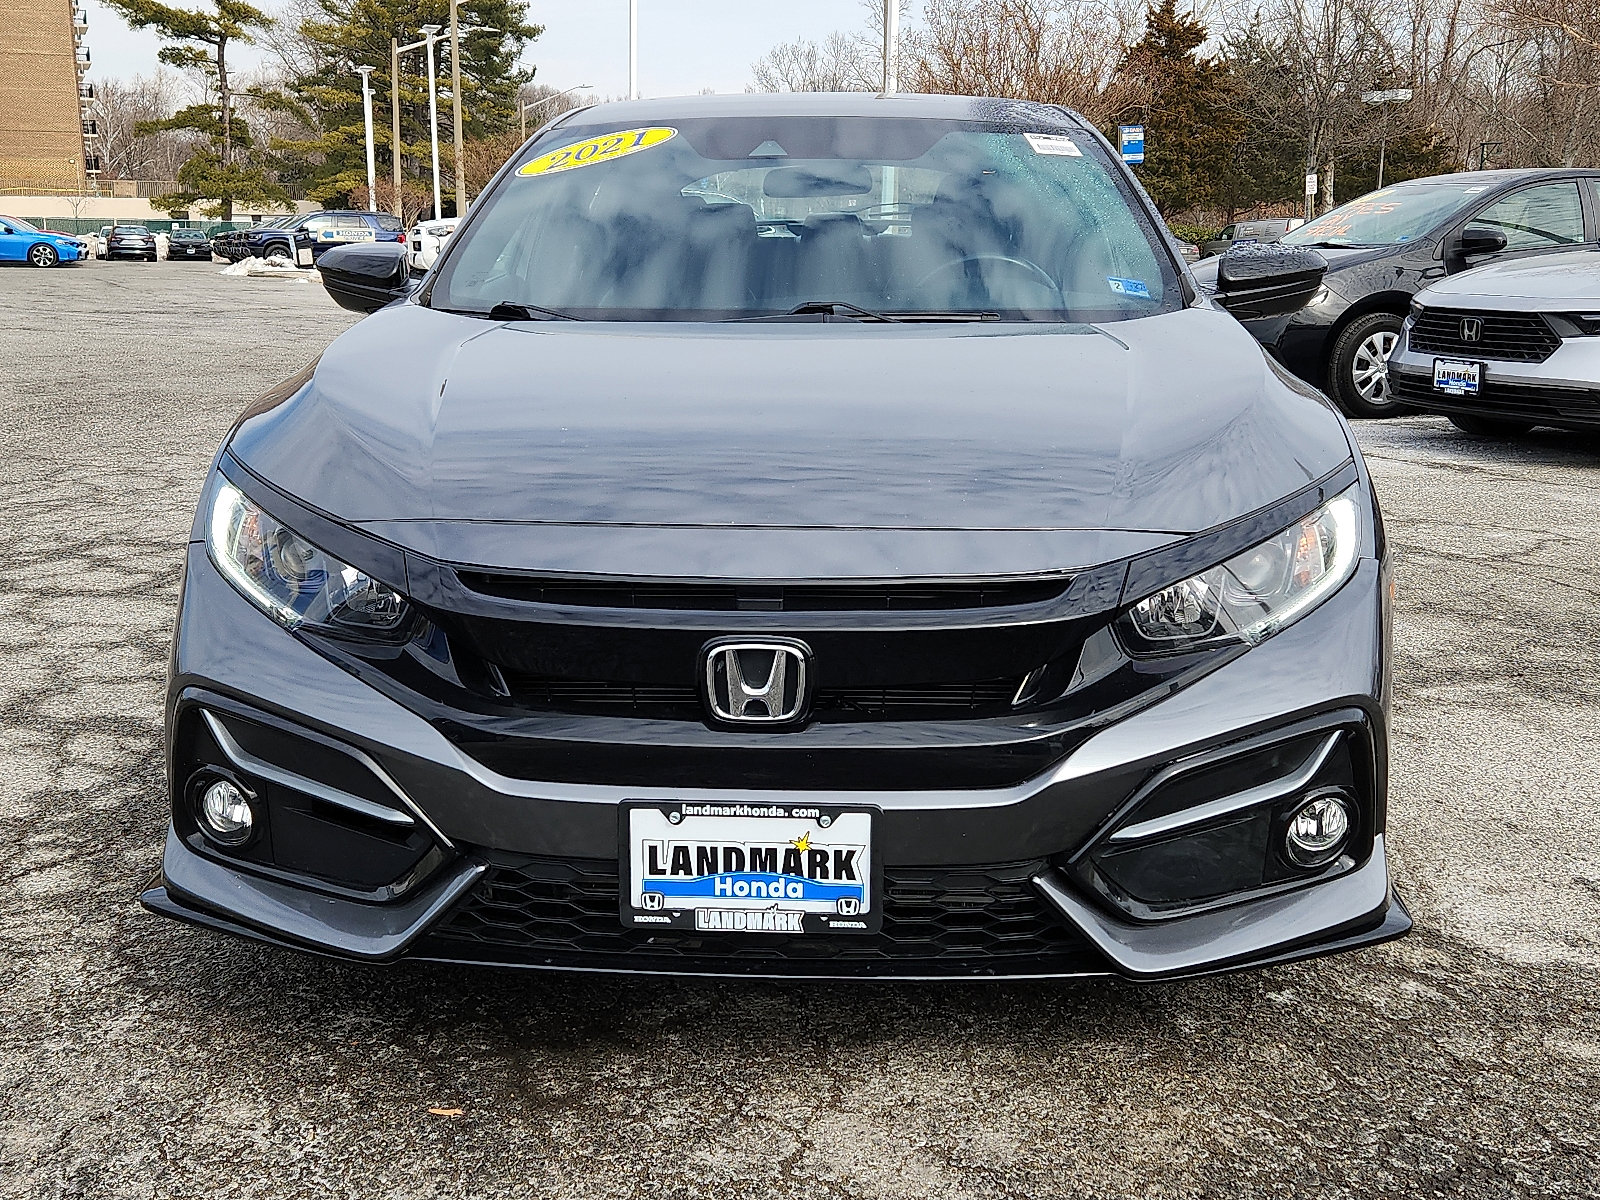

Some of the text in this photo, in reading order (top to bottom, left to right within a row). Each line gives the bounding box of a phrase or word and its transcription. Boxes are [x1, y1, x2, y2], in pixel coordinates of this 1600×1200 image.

[546, 131, 647, 170] 2021
[1437, 370, 1477, 382] LANDMARK
[647, 844, 857, 881] LANDMARK
[713, 876, 804, 899] Honda
[633, 915, 672, 924] HONDA
[698, 910, 802, 931] LANDMARK
[828, 920, 868, 929] HONDA
